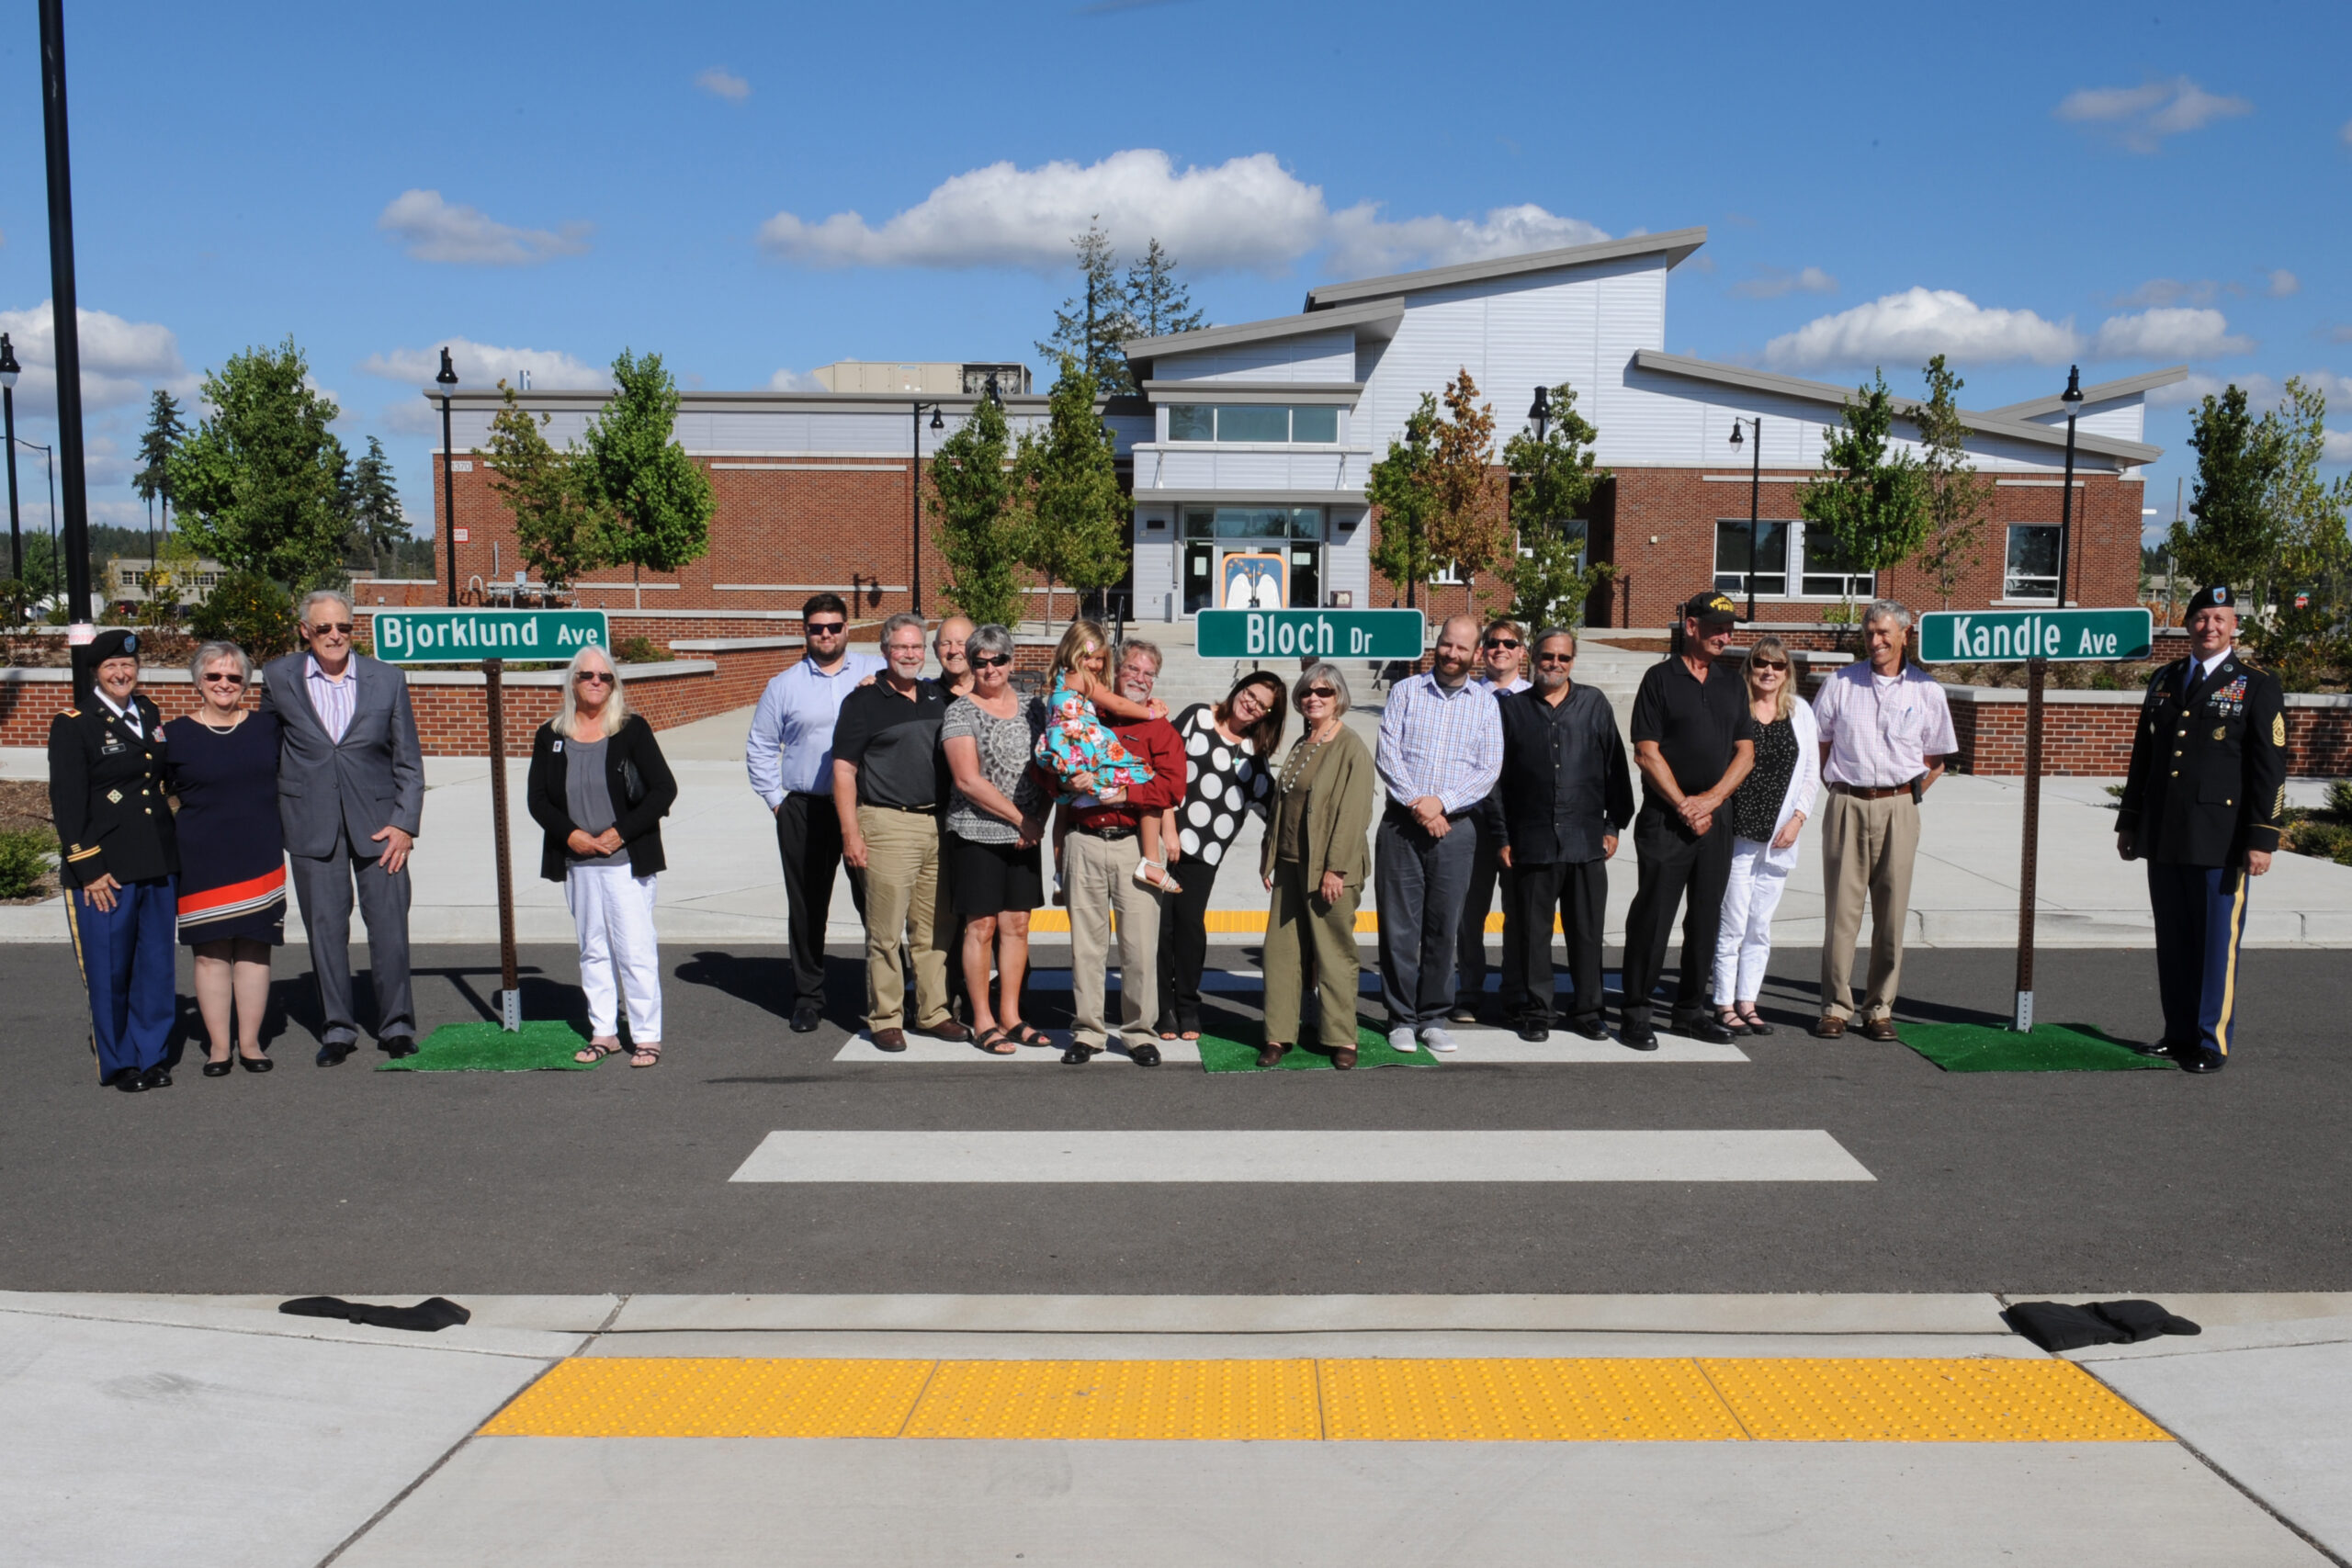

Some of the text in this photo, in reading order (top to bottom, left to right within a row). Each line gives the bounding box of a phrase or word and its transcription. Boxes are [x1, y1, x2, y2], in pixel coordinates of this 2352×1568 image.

[382, 616, 598, 658] Bjorklund Ave
[1247, 613, 1374, 655] Bloch Dr
[1953, 615, 2118, 658] Kandle Ave
